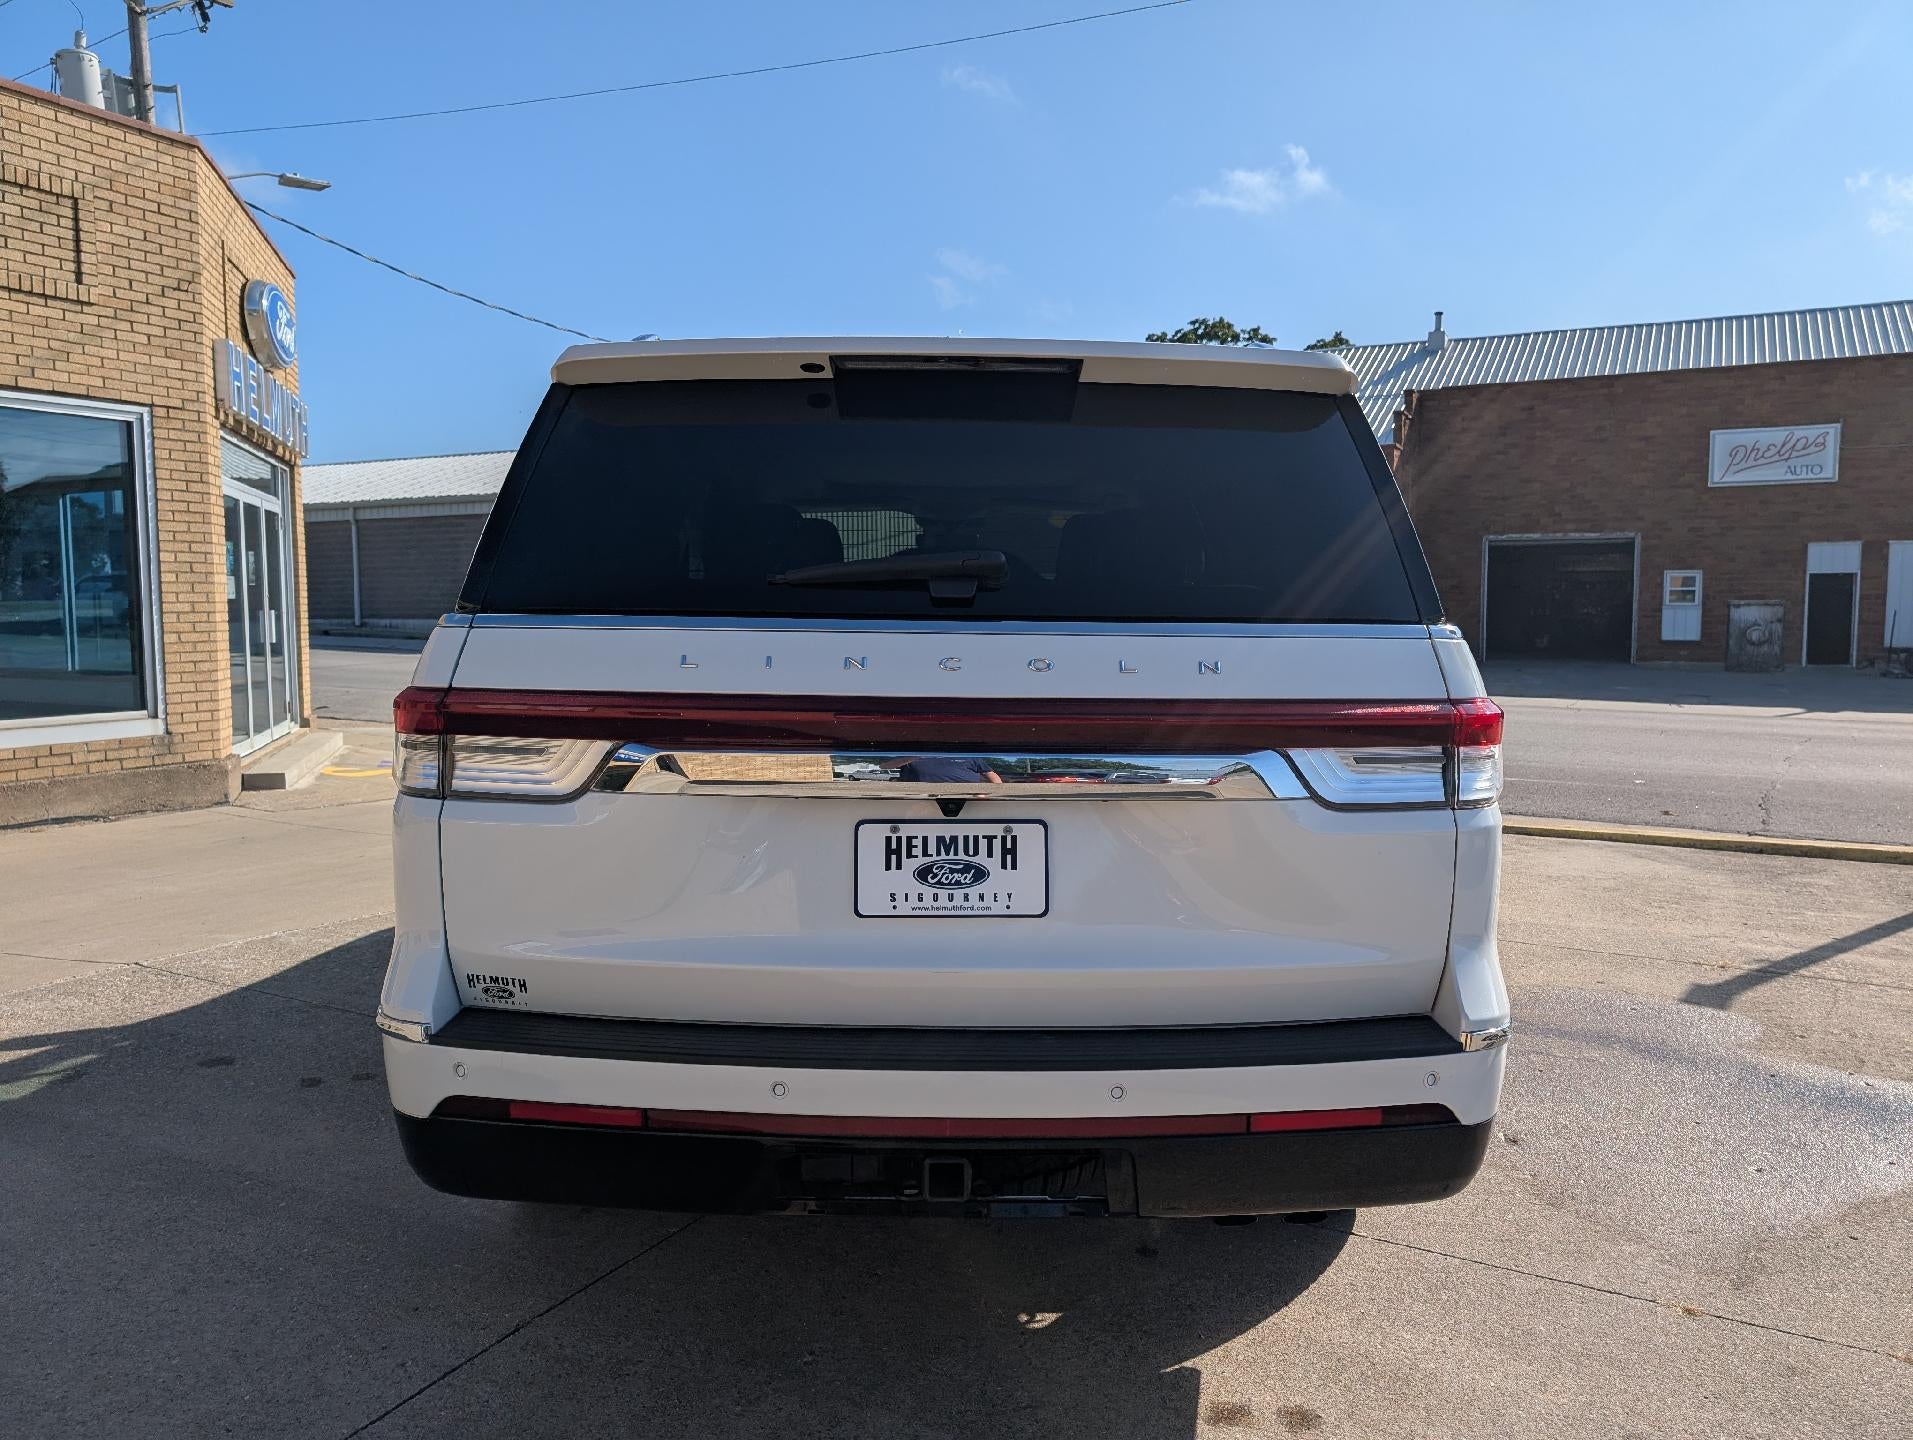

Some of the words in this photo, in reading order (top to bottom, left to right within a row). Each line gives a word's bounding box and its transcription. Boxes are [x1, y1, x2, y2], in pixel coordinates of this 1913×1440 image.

[276, 301, 296, 352] Ford
[229, 340, 309, 458] HELMUTH
[1720, 431, 1829, 480] Phelps
[1784, 464, 1823, 476] AUTO
[680, 654, 1222, 675] LINCOLN
[884, 834, 1018, 871] HELMUTH
[927, 863, 974, 884] Ford
[889, 892, 1013, 903] SIGOURNEY
[911, 904, 992, 912] www.helmuthford.com
[466, 973, 528, 994] HELMUTH
